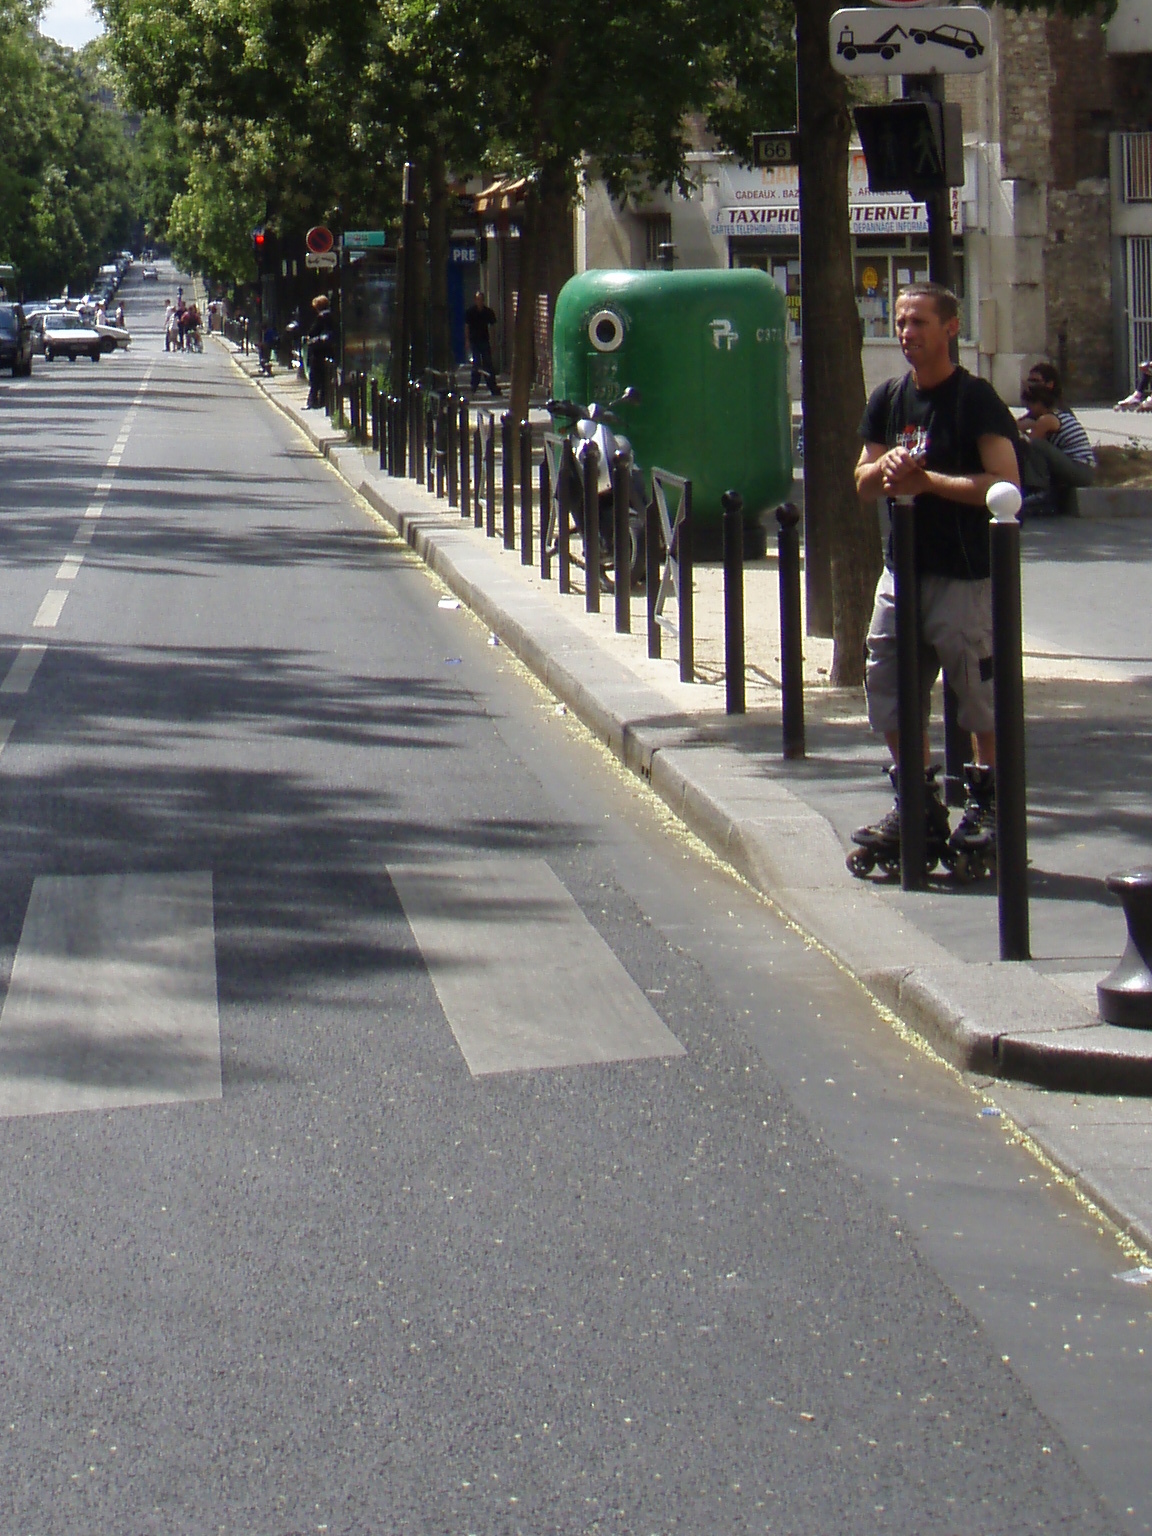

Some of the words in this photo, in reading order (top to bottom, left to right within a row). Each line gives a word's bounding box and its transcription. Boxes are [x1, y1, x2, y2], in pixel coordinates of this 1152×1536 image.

[764, 144, 787, 158] 66
[735, 190, 776, 199] CADEAUX
[452, 249, 476, 261] PRE
